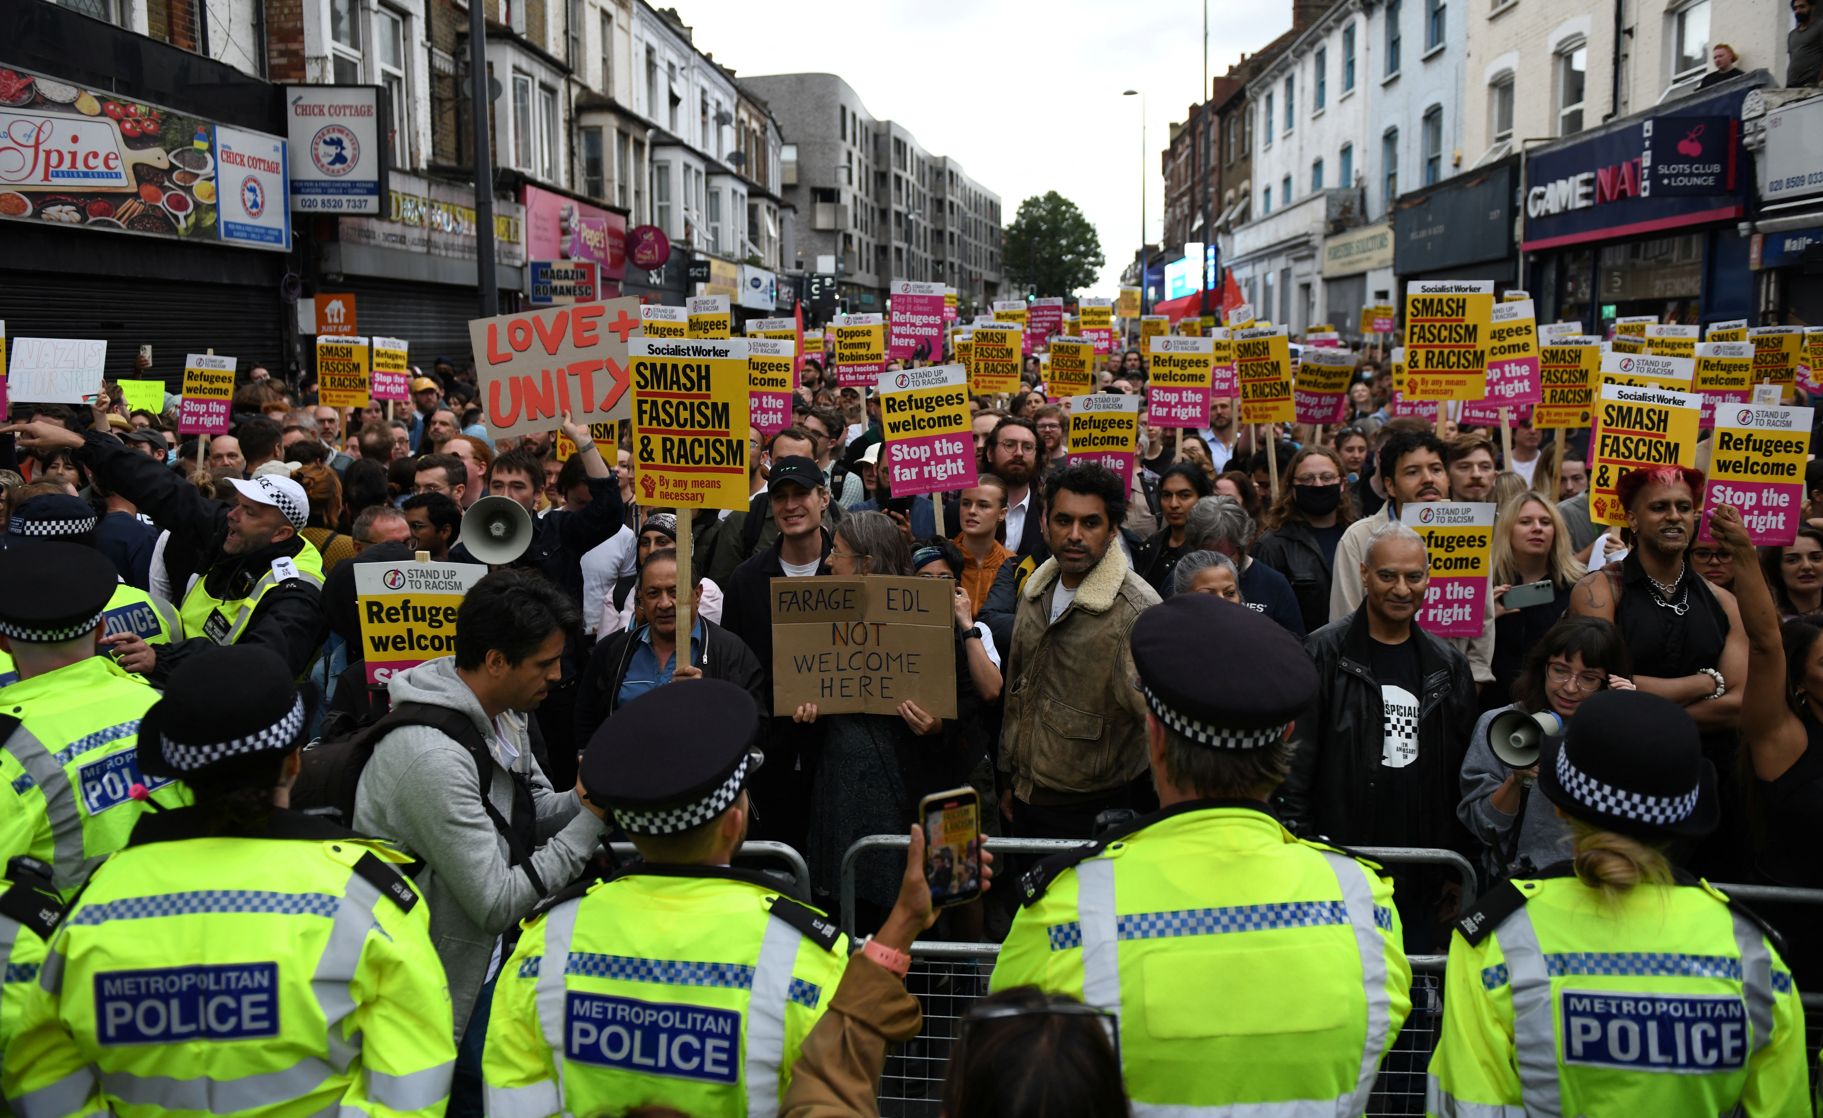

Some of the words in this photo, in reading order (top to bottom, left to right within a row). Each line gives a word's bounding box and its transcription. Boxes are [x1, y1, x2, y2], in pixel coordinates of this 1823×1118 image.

[295, 104, 325, 116] CHICK
[328, 105, 373, 117] COTTAGE
[221, 150, 246, 167] CHICK
[247, 156, 280, 174] COTTAGE
[1657, 164, 1691, 174] SLOTS
[1692, 163, 1721, 174] CLUB
[1671, 176, 1715, 186] LOUNGE
[1526, 171, 1595, 219] GAME
[301, 198, 317, 208] 020
[321, 199, 342, 208] 8520
[346, 199, 367, 209] 7337
[539, 268, 586, 281] MAGAZIN
[534, 284, 592, 297] ROMANESC
[1411, 298, 1466, 317] SMASH
[689, 318, 727, 334] Refugees
[892, 312, 941, 325] Refugees
[487, 306, 606, 365] LOVE
[837, 328, 872, 339] Oppose
[892, 325, 938, 335] welcome
[975, 332, 1006, 343] SMASH
[1410, 324, 1478, 343] FASCISM
[837, 340, 871, 351] Tommy
[892, 336, 915, 347] here
[1648, 339, 1695, 351] Refugees
[13, 340, 104, 369] NAZIS
[319, 346, 352, 358] SMASH
[838, 352, 882, 362] Robinson
[975, 348, 1013, 359] FASCISM
[1052, 345, 1080, 355] SMASH
[1237, 341, 1270, 358] SMASH
[1542, 349, 1581, 364] SMASH
[749, 358, 790, 373] fugees
[1051, 358, 1086, 369] FASCISM
[1153, 355, 1209, 370] Refugees
[1408, 351, 1419, 369] &
[1425, 350, 1485, 369] RACISM
[1702, 360, 1749, 374] Refugees
[320, 362, 360, 373] FASCISM
[1239, 361, 1281, 378] FASCISM
[1301, 365, 1350, 379] Refugees
[1504, 363, 1530, 377] the
[1756, 368, 1794, 381] RACISM
[11, 371, 34, 395] OFF
[34, 371, 58, 395] OUR
[187, 371, 232, 384] Refugees
[320, 377, 326, 387] &
[330, 377, 366, 389] RACISM
[636, 362, 711, 392] SMASH
[911, 371, 932, 380] STAND
[922, 377, 948, 385] RACISM
[1153, 371, 1206, 382] welcome
[1541, 369, 1589, 384] FASCISM
[1701, 375, 1745, 386] welcome
[186, 384, 229, 396] welcome
[1242, 385, 1249, 399] &
[1252, 381, 1291, 398] RACISM
[1298, 378, 1344, 389] welcome
[1495, 380, 1531, 397] right
[488, 357, 630, 428] UNITY
[1152, 389, 1179, 403] Stop
[1183, 390, 1203, 402] the
[1550, 389, 1593, 404] RACISM
[183, 400, 207, 414] Stop
[209, 401, 226, 413] the
[885, 392, 965, 413] Refugees
[636, 399, 730, 430] FASCISM
[751, 410, 783, 426] right
[1151, 404, 1169, 417] far
[1171, 404, 1201, 420] right
[1309, 405, 1334, 417] right
[1603, 404, 1669, 433] SMASH
[182, 414, 197, 425] far
[199, 415, 224, 427] right
[888, 412, 963, 434] welcome
[1073, 417, 1133, 432] Refugees
[1072, 434, 1128, 447] welcome
[1718, 432, 1804, 457] Refugees
[638, 436, 655, 463] &
[662, 437, 744, 466] RACISM
[891, 443, 930, 462] Stop
[934, 439, 964, 457] the
[1600, 435, 1680, 464] FASCISM
[1101, 455, 1125, 469] the
[1716, 457, 1797, 476] welcome
[893, 464, 920, 482] far
[923, 458, 965, 480] right
[1596, 465, 1610, 487] &
[659, 476, 669, 488] By
[671, 479, 688, 490] any
[691, 478, 721, 488] means
[659, 490, 705, 503] necessary
[1711, 485, 1757, 509] Stop
[1762, 488, 1790, 507] the
[1436, 508, 1459, 516] STAND
[1461, 508, 1471, 516] UP
[1744, 511, 1785, 533] right
[407, 569, 440, 580] STAND
[443, 570, 456, 580] UP
[410, 580, 422, 589] TO
[425, 580, 462, 591] RACISM
[1446, 582, 1475, 599] the
[778, 588, 856, 612] FARAGE
[886, 588, 929, 613] EDL
[366, 599, 457, 628] Refuge
[1427, 604, 1471, 626] right
[832, 621, 887, 647] NOT
[793, 651, 922, 674] WELCOME
[821, 675, 894, 699] HERE
[103, 970, 271, 997] METROPOLITAN
[1569, 996, 1742, 1019] METROPOLITAN
[105, 994, 271, 1038] POLICE
[572, 998, 732, 1036] METROPOLITAN
[571, 1021, 730, 1075] POLICE
[1570, 1016, 1743, 1065] POLICE
